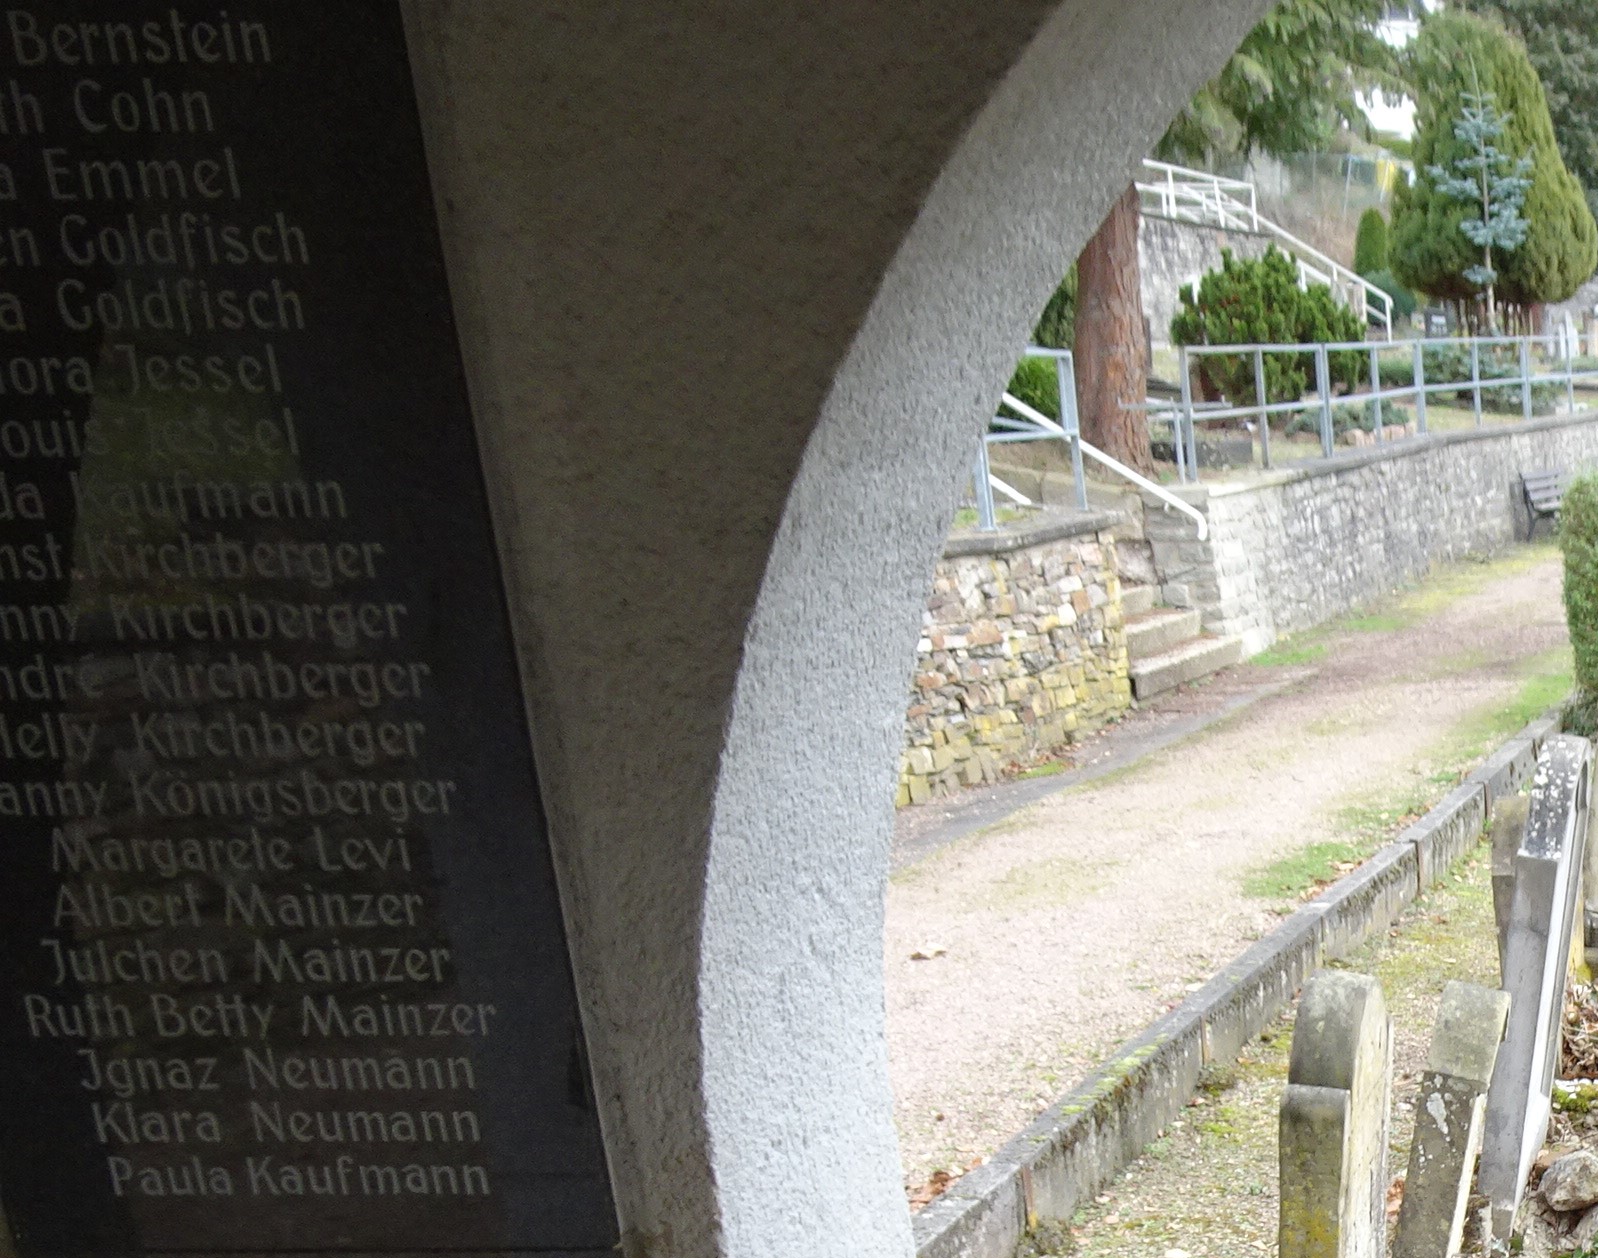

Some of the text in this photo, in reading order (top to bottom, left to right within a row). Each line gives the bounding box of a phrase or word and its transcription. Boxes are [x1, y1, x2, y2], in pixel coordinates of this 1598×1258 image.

[7, 8, 272, 66] Bernstein
[74, 78, 214, 133] Cohn
[43, 146, 241, 200] Emmel
[60, 212, 309, 270] Goldfisch
[56, 278, 304, 335] Goldfisch
[114, 343, 282, 395] Jessel
[132, 406, 299, 455] Jessel
[69, 470, 347, 523] Kaufmann
[83, 532, 386, 588] Kirchberger
[109, 592, 408, 649] Kirchberger
[134, 650, 431, 708] Kirchberger
[129, 710, 426, 766] Kirchberger
[129, 768, 458, 822] Königsberger
[52, 826, 412, 878] Margarete Levi
[54, 884, 423, 927] Albert Mainzer
[40, 938, 452, 984] Julchen Mainzer
[24, 993, 496, 1039] Ruth Betty Mainzer
[243, 1046, 475, 1091] Neumann
[91, 1100, 480, 1144] Klara Neumann
[108, 1155, 490, 1198] Paula Kaufmann
